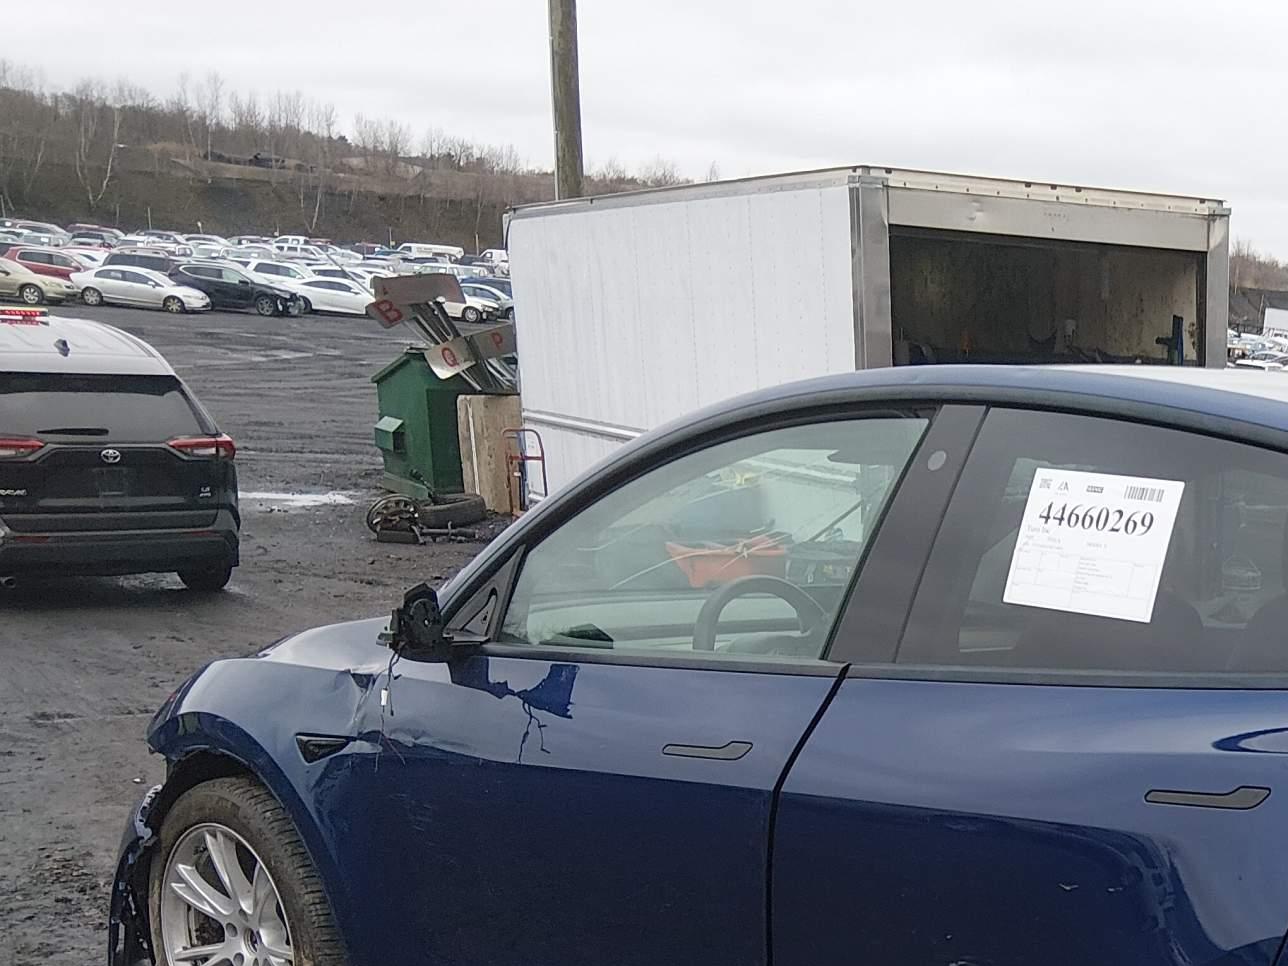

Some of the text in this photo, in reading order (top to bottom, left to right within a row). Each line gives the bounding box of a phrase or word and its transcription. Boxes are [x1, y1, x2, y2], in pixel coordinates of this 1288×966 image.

[376, 301, 404, 323] B
[442, 348, 460, 368] Q
[1039, 501, 1154, 536] 44660269
